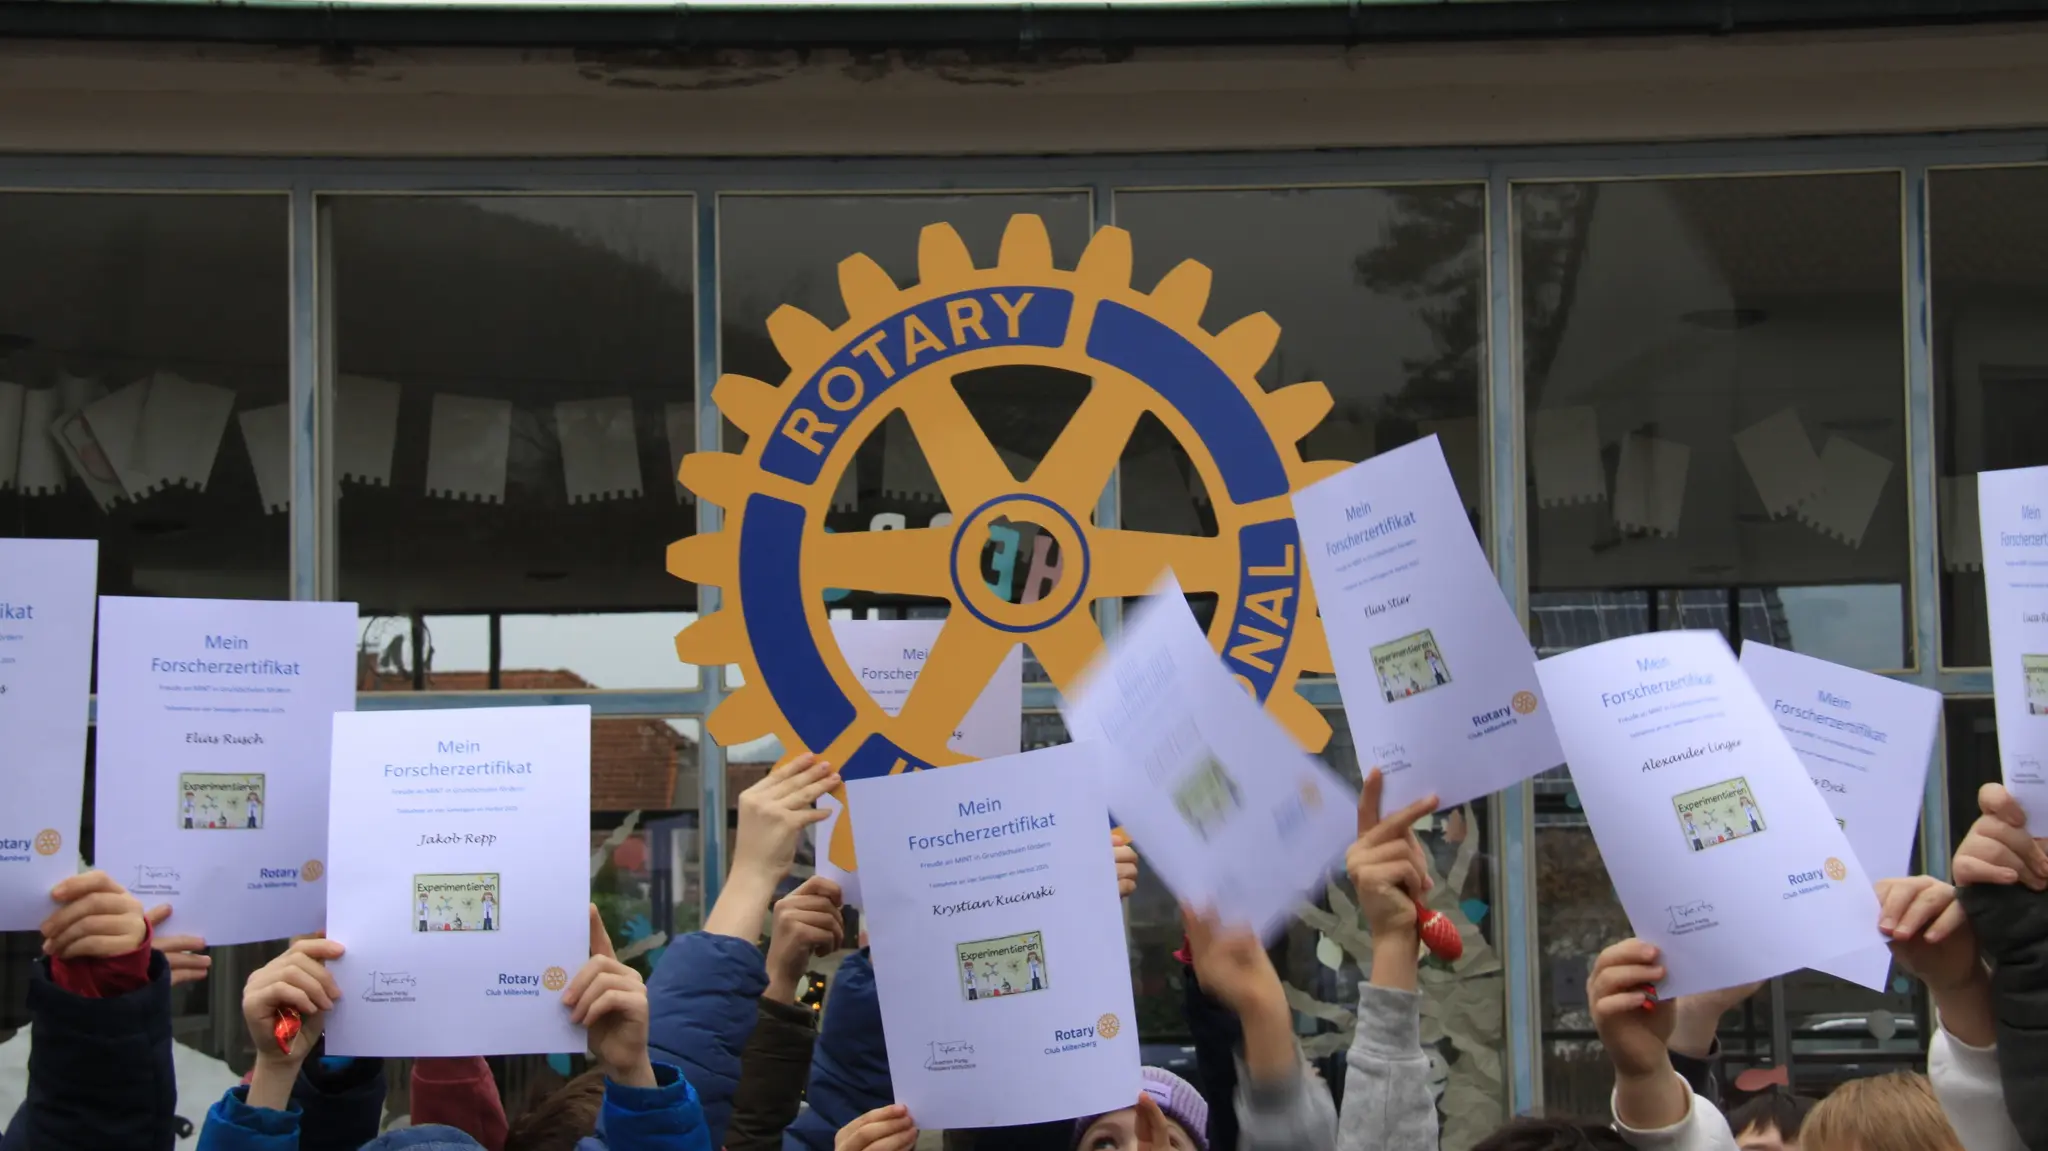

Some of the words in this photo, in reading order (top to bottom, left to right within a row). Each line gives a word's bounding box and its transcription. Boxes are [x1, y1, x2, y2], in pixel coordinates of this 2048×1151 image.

[781, 289, 1036, 456] ROTARY
[1344, 501, 1372, 522] Mein
[2021, 504, 2041, 520] Mein
[1325, 511, 1417, 557] Forscherzertifikat
[1387, 593, 1412, 609] Stier
[204, 634, 249, 650] Mein
[902, 648, 929, 660] Mei
[151, 657, 301, 676] Forscherzertifikat
[1601, 673, 1715, 708] Forscherzertifikat
[1817, 689, 1852, 710] Mein
[1471, 705, 1512, 727] Rotary
[1773, 698, 1889, 744] Forscherzertifikat
[222, 733, 265, 746] Rusch
[438, 739, 481, 754] Mein
[1641, 745, 1706, 773] Alexander
[384, 760, 533, 778] Forscherzertifikat
[183, 781, 261, 792] Experimentieren
[958, 797, 1003, 818] Mein
[1677, 785, 1747, 813] Experimentieren
[416, 832, 462, 847] Jakob
[464, 832, 498, 847] Repp
[908, 812, 1056, 851] Forscherzertifikat
[260, 867, 299, 880] Rotary
[1787, 868, 1824, 886] Rotary
[417, 882, 496, 893] Experimentieren
[932, 897, 995, 918] Krystian
[994, 885, 1056, 907] Kucinski
[960, 942, 1039, 961] Experimentieren
[498, 972, 540, 986] Rotary
[486, 988, 501, 996] Club
[502, 988, 540, 997] Miltenberg
[1054, 1024, 1095, 1042] Rotary
[1044, 1045, 1061, 1055] Club
[1061, 1040, 1097, 1053] Miltenberg
